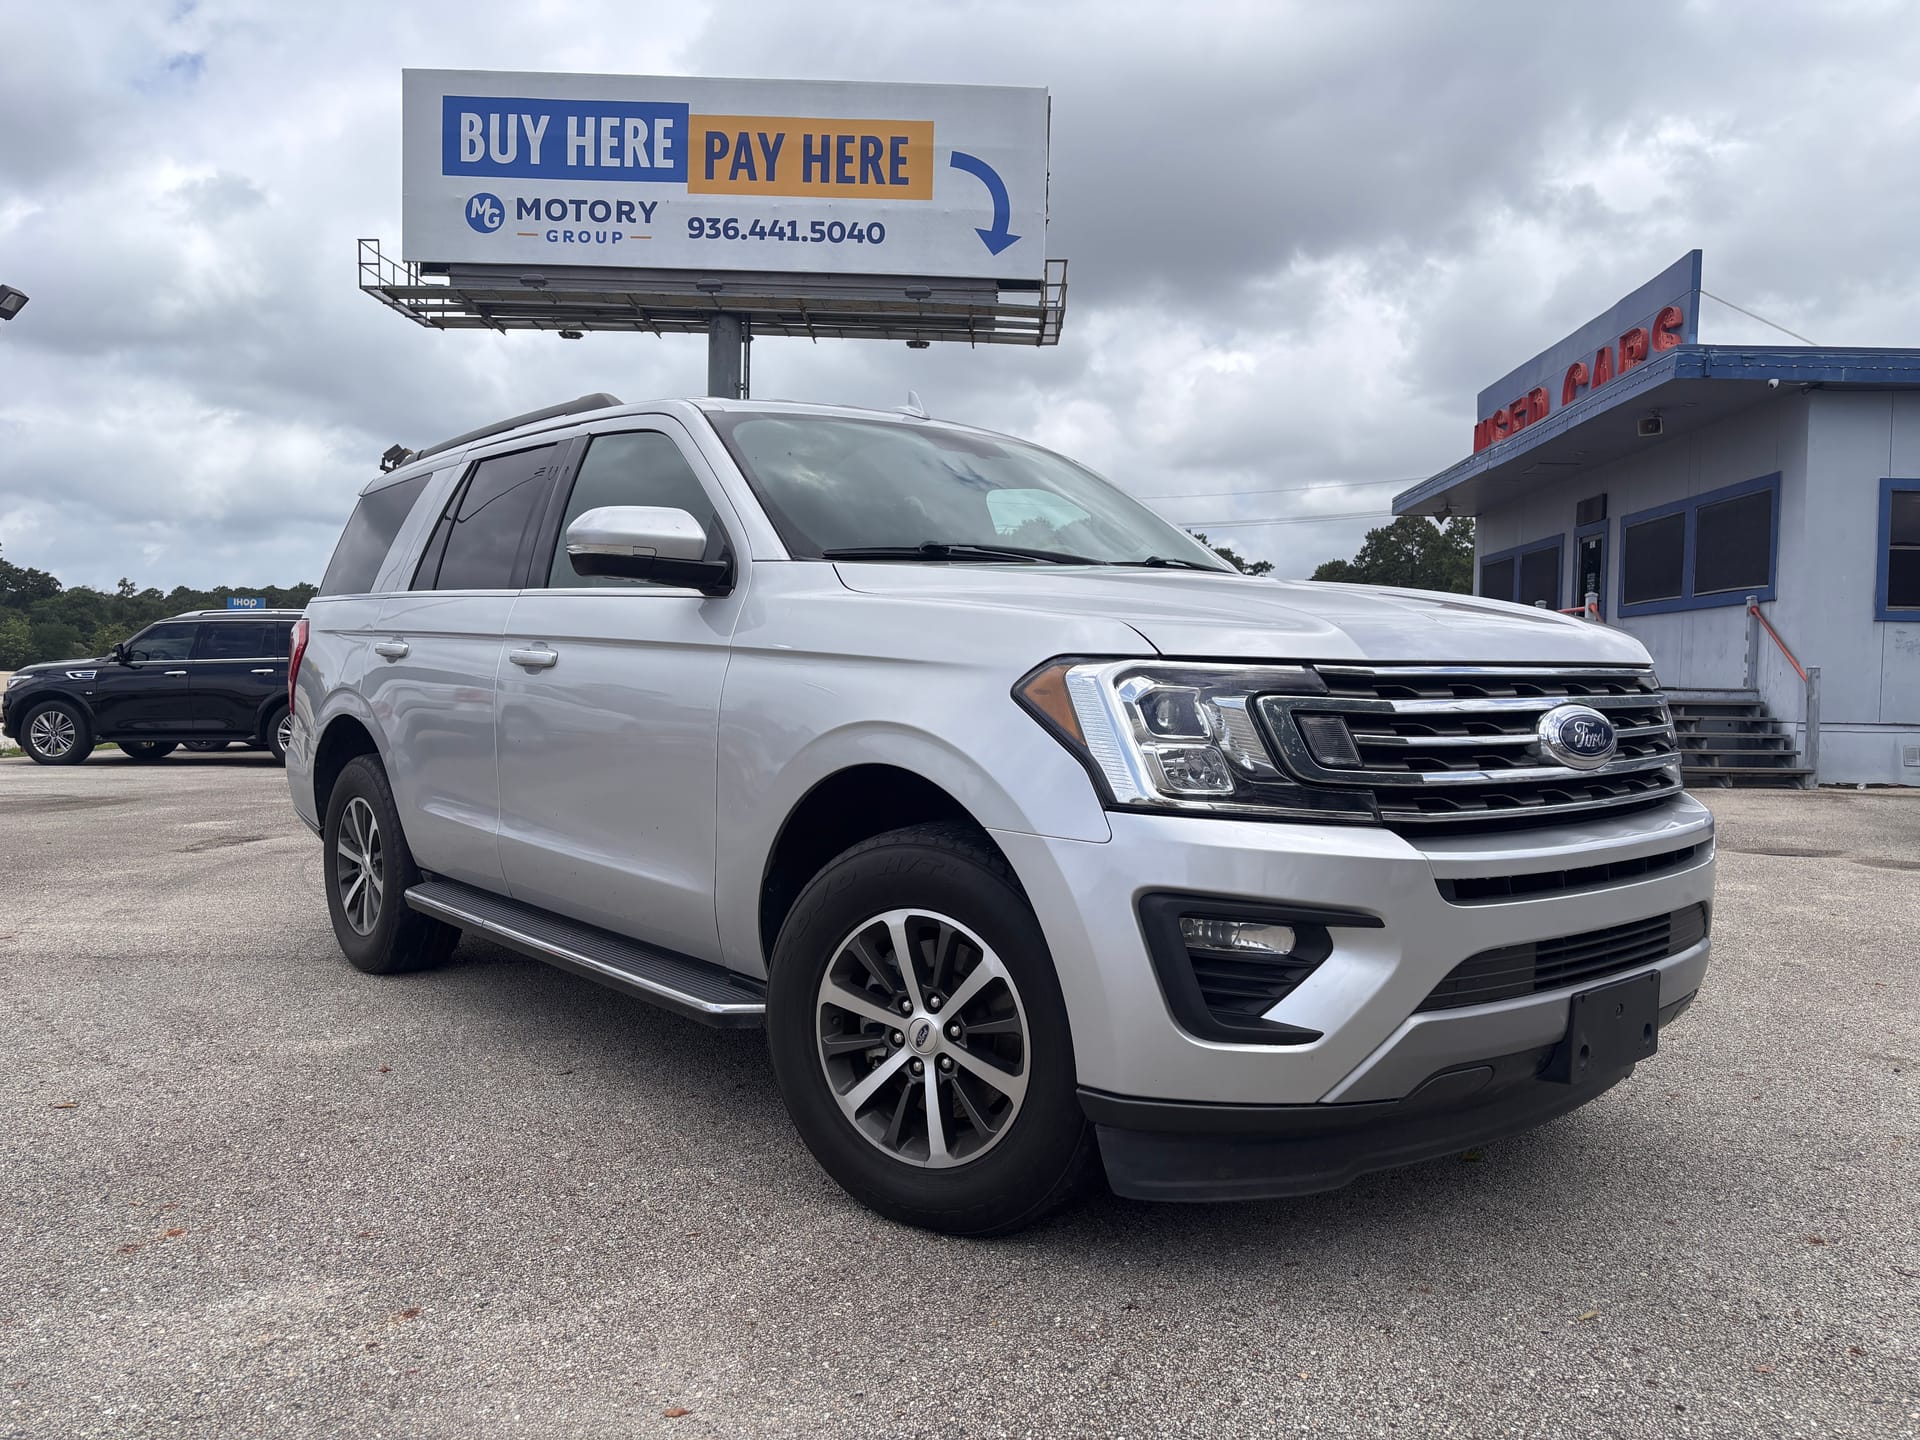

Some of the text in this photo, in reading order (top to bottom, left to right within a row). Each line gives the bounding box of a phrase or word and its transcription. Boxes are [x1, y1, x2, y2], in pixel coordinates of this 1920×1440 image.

[460, 112, 675, 169] BUY HERE
[704, 131, 910, 186] PAY HERE
[470, 197, 501, 229] MG
[516, 197, 658, 224] MOTORY
[545, 229, 623, 244] GROUP
[687, 216, 886, 245] 936.441.5040
[1574, 721, 1607, 748] Ford
